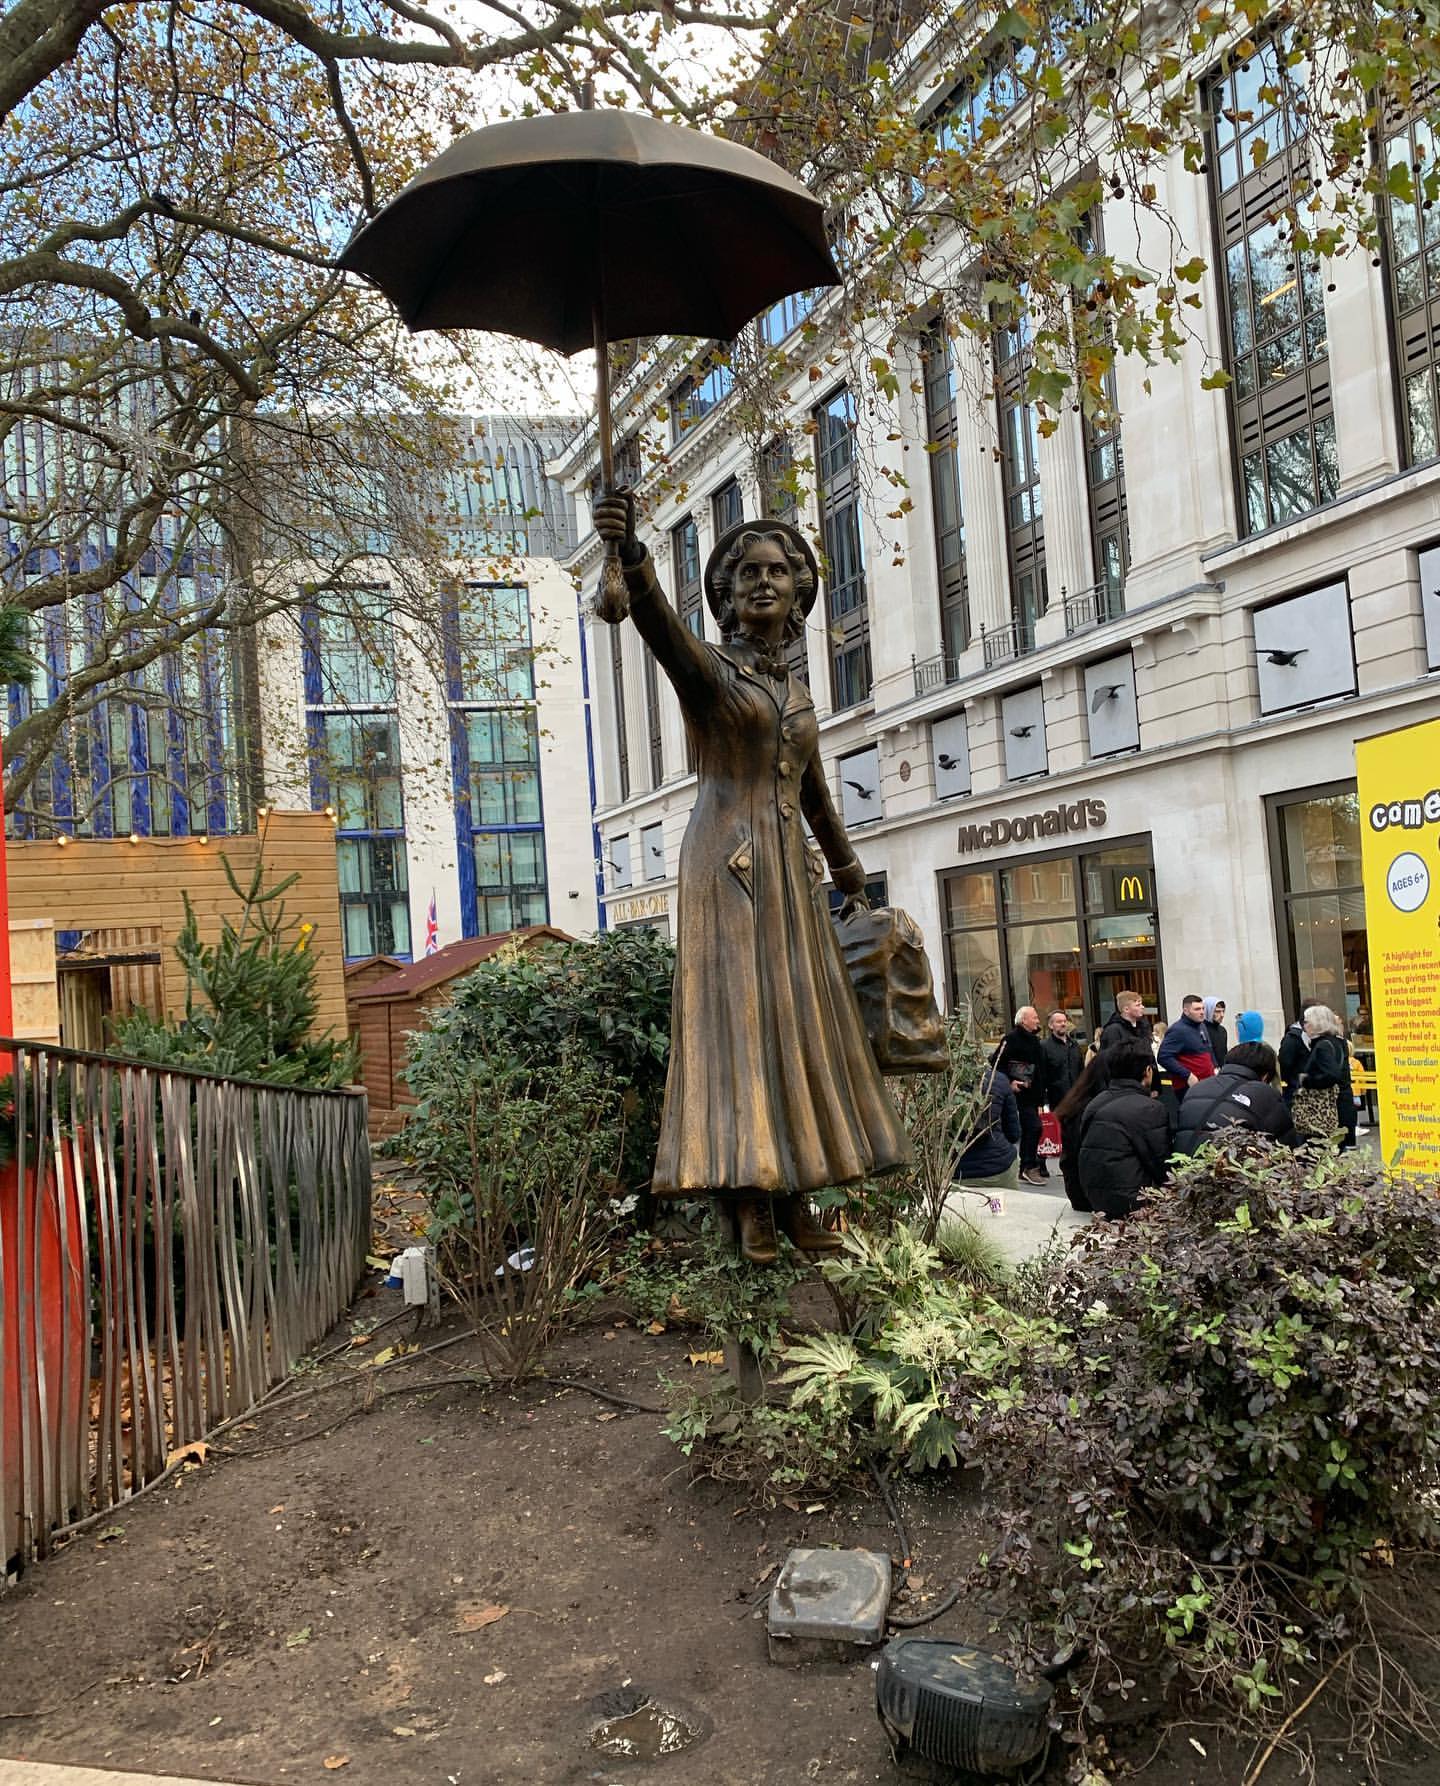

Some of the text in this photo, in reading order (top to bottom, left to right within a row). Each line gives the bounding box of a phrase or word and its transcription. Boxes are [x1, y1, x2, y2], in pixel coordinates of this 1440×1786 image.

[1369, 789, 1440, 832] come
[957, 798, 1107, 853] McDonald's
[1392, 872, 1424, 892] AGES 6+
[1391, 950, 1421, 961] highlight
[1422, 949, 1432, 958] for
[1383, 963, 1410, 973] children
[1405, 973, 1426, 984] giving
[1390, 986, 1408, 995] taste
[1409, 985, 1416, 994] of
[1417, 985, 1437, 993] some
[1385, 996, 1432, 1008] of the biggest
[1409, 1008, 1416, 1017] in
[1408, 1020, 1420, 1029] the
[1408, 1031, 1422, 1041] feel
[1423, 1031, 1431, 1040] of
[1393, 1056, 1438, 1067] The Guardian
[1397, 1112, 1416, 1122] Three
[1399, 1141, 1416, 1152] Daily
